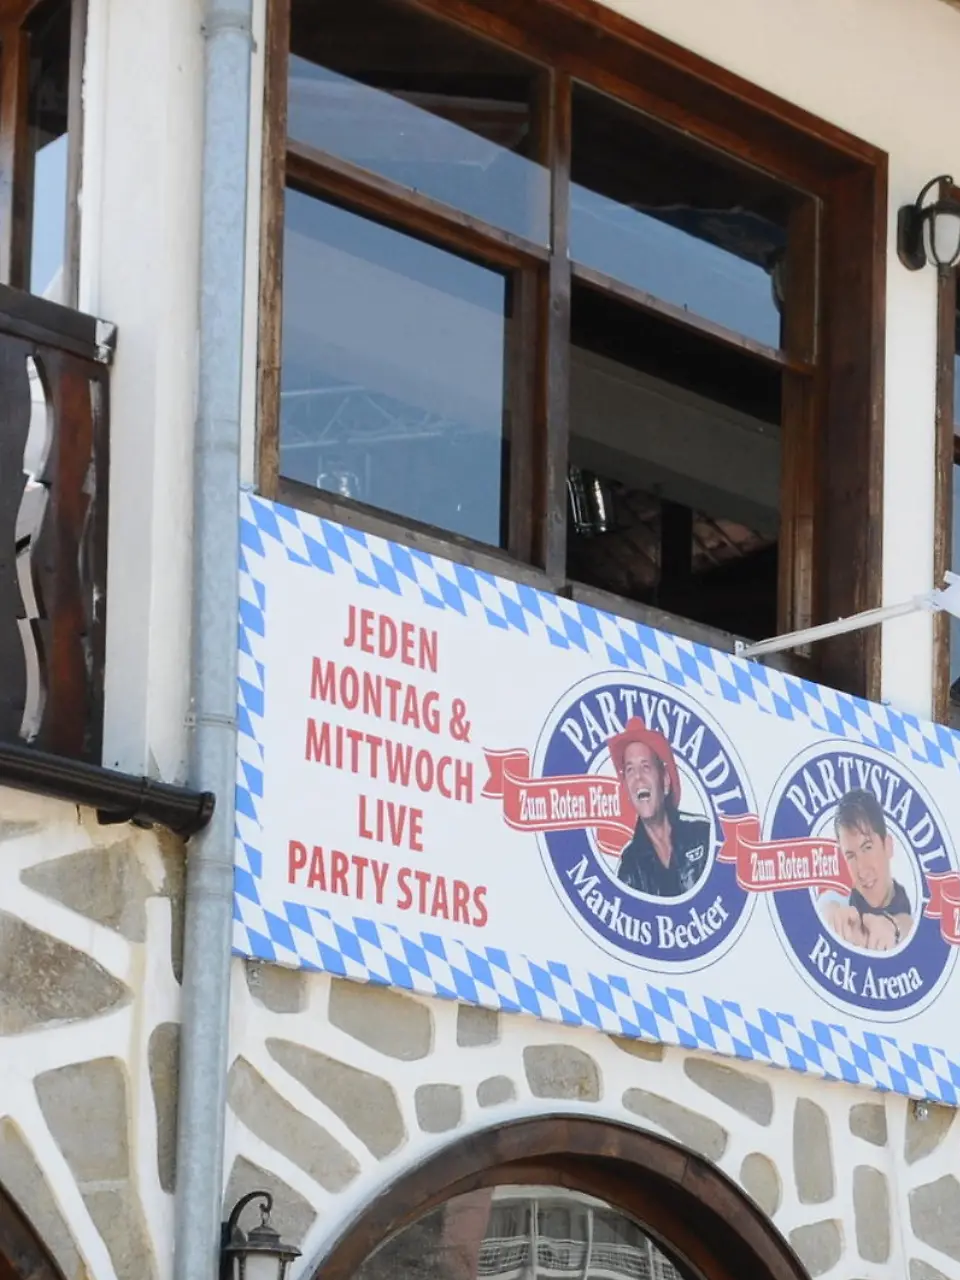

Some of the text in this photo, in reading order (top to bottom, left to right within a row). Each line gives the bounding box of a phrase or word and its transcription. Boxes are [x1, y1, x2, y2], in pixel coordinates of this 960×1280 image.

[343, 604, 439, 673] JEDEN
[310, 656, 471, 742] MONTAG &
[305, 717, 474, 804] MITTWOCH
[560, 688, 742, 813] PARTYSTADL
[357, 794, 423, 852] LIVE
[519, 782, 621, 821] Zum Roten Pferd
[288, 840, 488, 927] PARTY STARS
[566, 853, 729, 950] Markus Becker
[750, 848, 840, 882] Zum Roten Pferd
[809, 933, 923, 1000] Rick Arena
